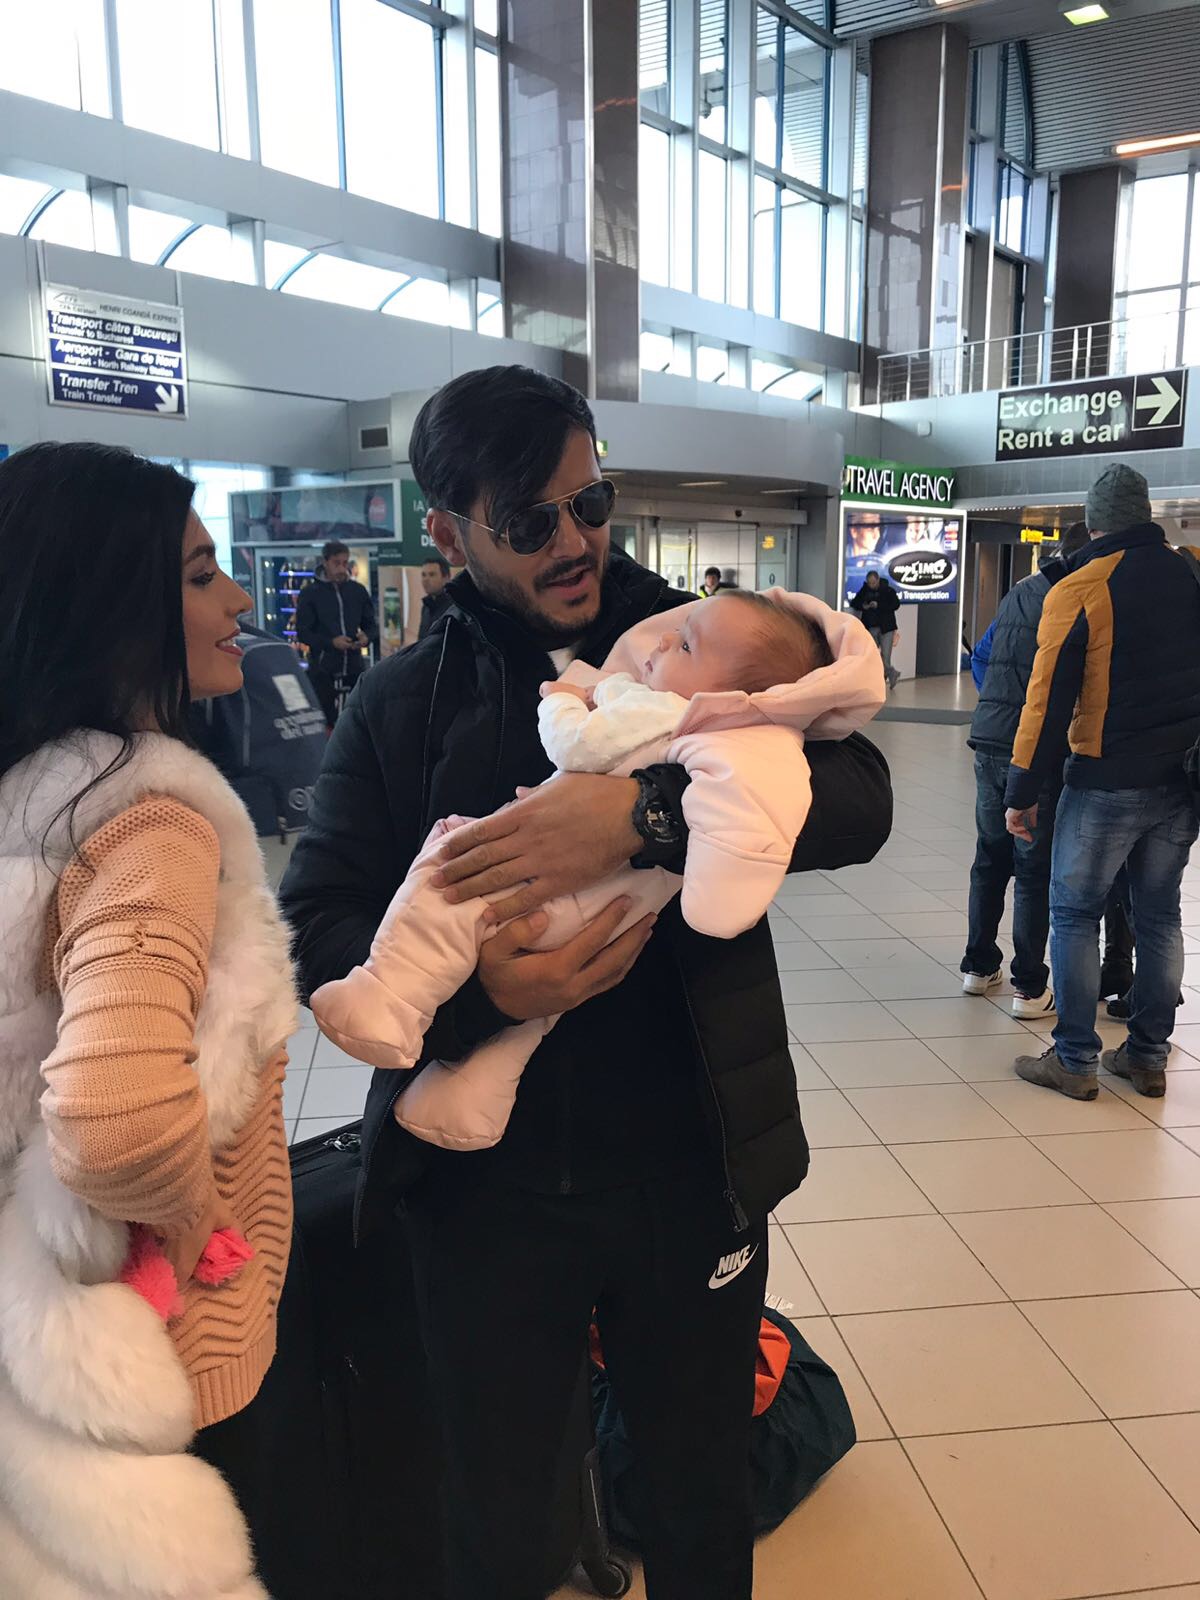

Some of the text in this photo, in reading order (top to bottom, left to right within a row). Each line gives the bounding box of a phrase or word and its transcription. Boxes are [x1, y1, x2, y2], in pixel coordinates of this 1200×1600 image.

[51, 311, 103, 330] Transport
[99, 304, 121, 314] HENRI
[152, 313, 177, 323] EXPRES
[53, 324, 134, 345] Transfer to Bucharest
[55, 340, 103, 357] Aeroport
[114, 348, 139, 362] Gara
[141, 353, 154, 364] de
[155, 355, 179, 368] Nord
[64, 355, 92, 367] Airport
[98, 358, 119, 371] North
[120, 361, 149, 375] Railway
[149, 365, 174, 377] Station
[59, 373, 138, 395] Transfer Tren
[63, 389, 123, 404] Train Transfer
[999, 390, 1123, 419] Exchange
[998, 422, 1125, 451] Rent a car
[846, 465, 898, 498] TRAVEL
[900, 472, 955, 502] AGENCY
[903, 590, 950, 601] Transportation
[716, 1243, 751, 1277] NIKE
